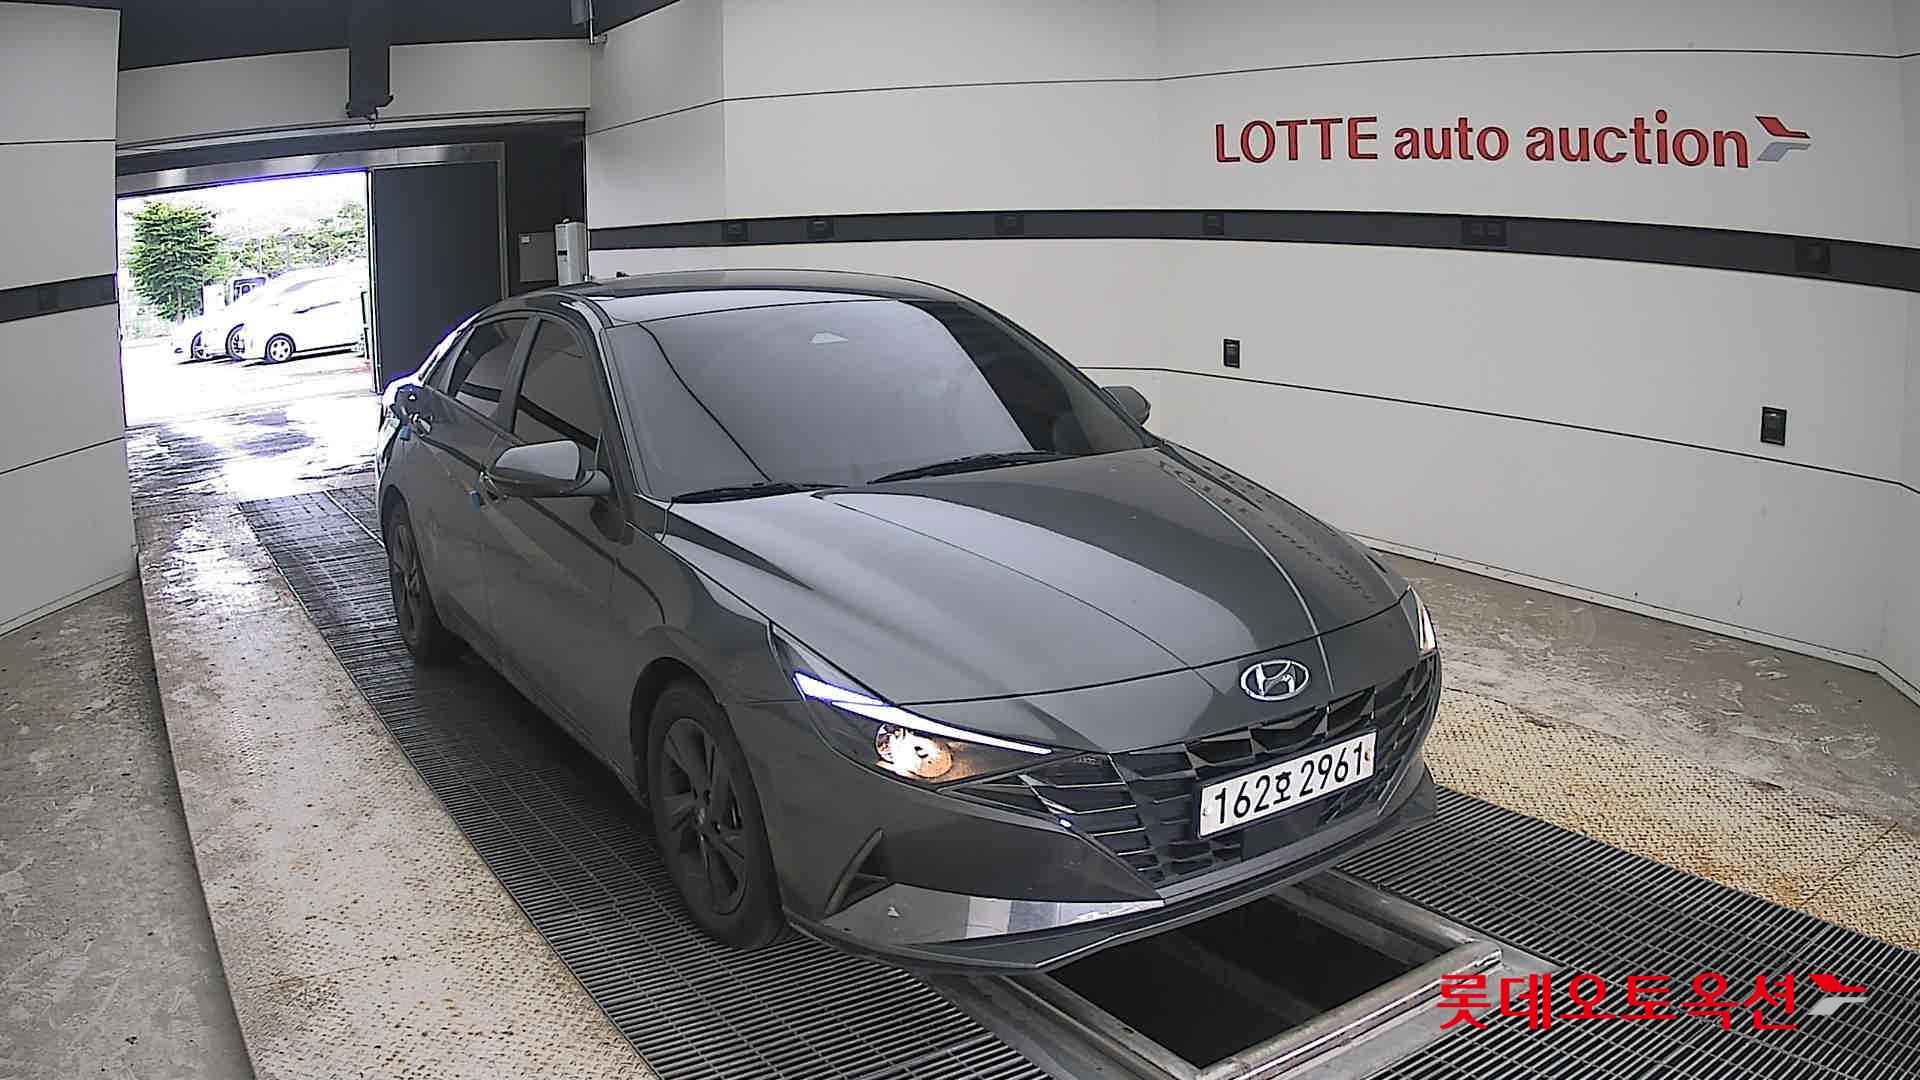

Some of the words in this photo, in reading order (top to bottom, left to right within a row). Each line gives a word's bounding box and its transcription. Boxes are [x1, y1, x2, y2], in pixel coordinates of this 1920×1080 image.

[1215, 116, 1378, 163] LOTTE
[1393, 117, 1510, 162] auto
[1525, 110, 1750, 168] auction
[1214, 771, 1292, 824] 162호
[1299, 741, 1363, 797] 2961
